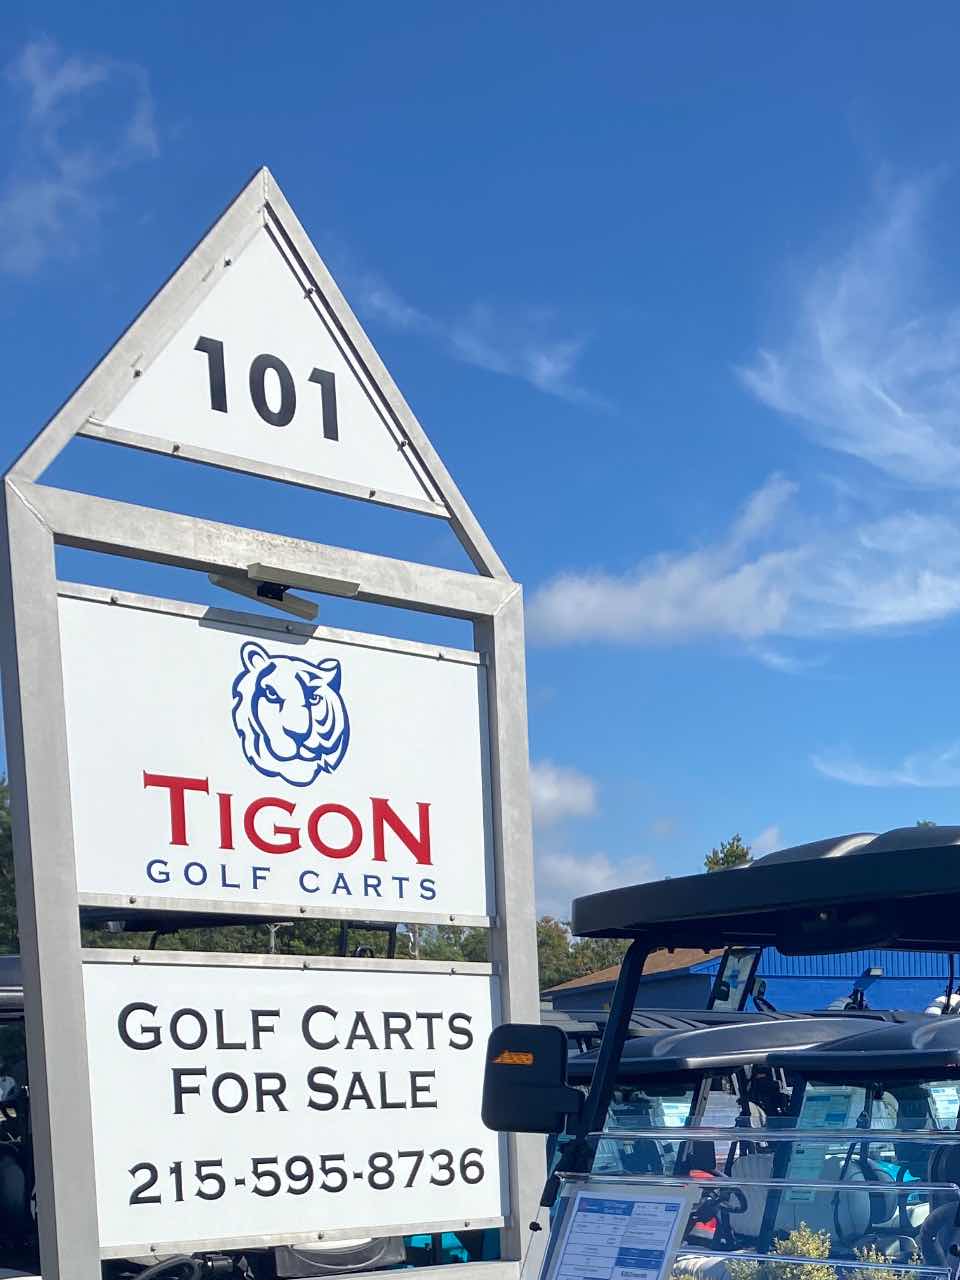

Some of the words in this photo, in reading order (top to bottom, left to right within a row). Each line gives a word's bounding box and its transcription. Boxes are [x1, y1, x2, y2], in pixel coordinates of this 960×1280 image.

[194, 336, 339, 442] 101
[143, 770, 434, 866] TIGON
[146, 859, 271, 890] GOLF
[298, 870, 436, 901] CARTS
[117, 1001, 281, 1051] GOLF
[301, 1004, 474, 1051] CARTS
[171, 1065, 289, 1115] FOR
[306, 1066, 438, 1112] SALE
[127, 1147, 485, 1206] 215-595-8736
